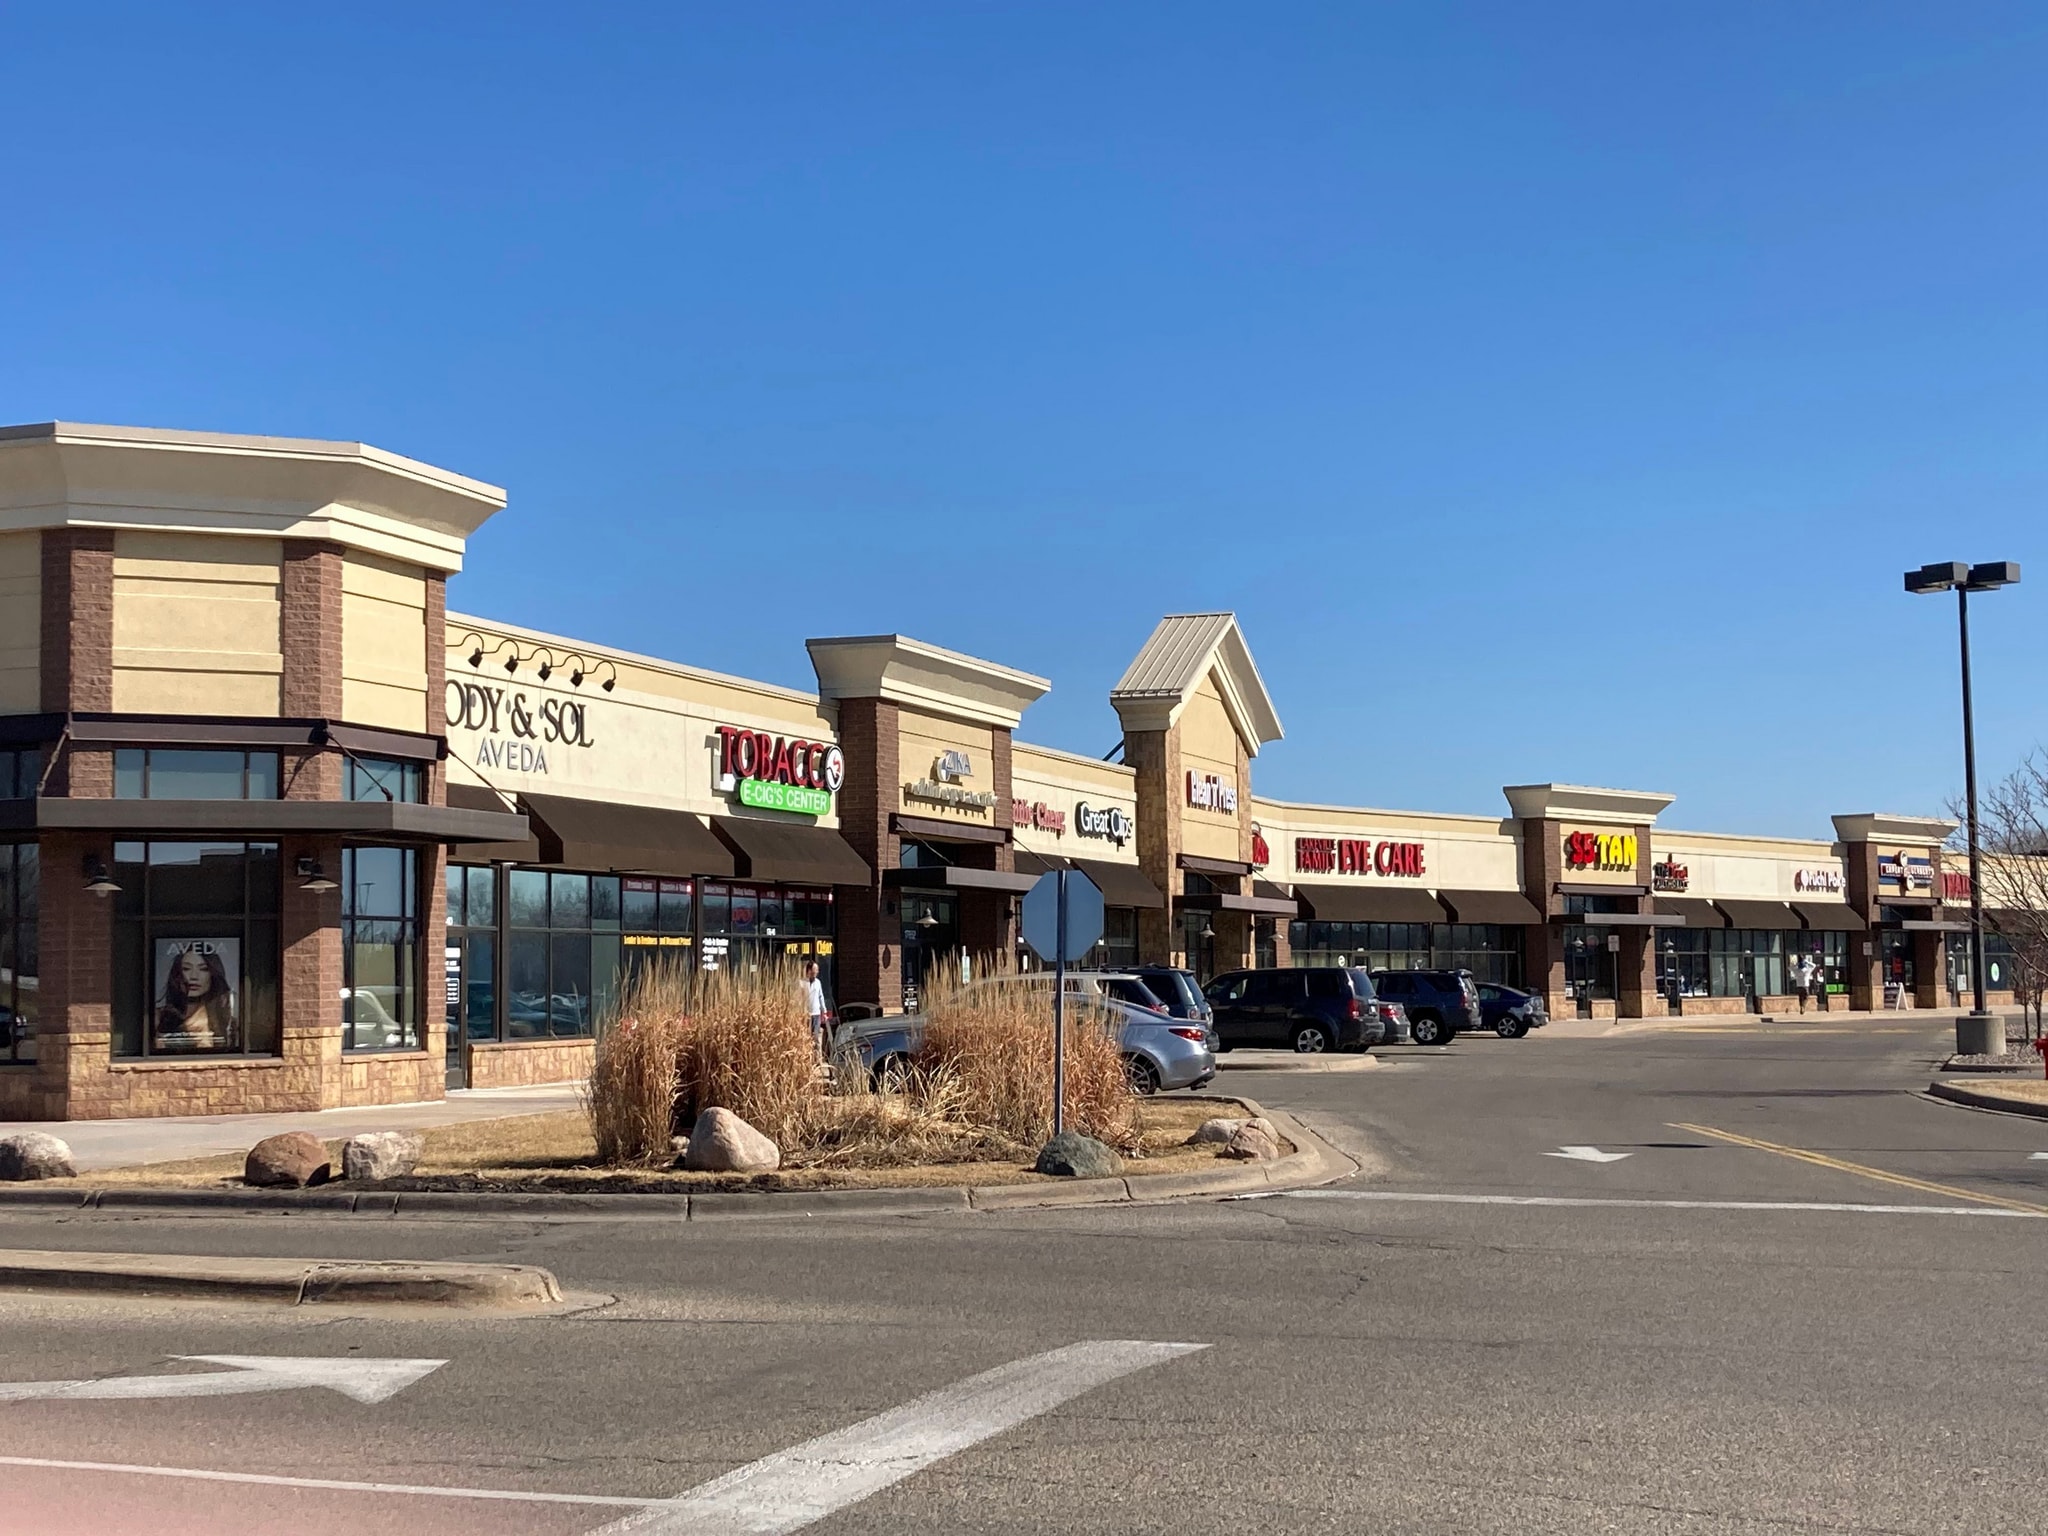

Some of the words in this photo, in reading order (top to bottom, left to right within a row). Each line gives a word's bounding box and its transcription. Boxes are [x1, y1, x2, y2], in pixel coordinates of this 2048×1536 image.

[445, 679, 505, 733] ODY
[511, 692, 538, 740] &
[544, 698, 594, 748] SOL
[476, 737, 548, 775] AVEDA
[743, 782, 784, 804] E-CIG'S
[786, 790, 828, 811] CENTER
[1080, 803, 1110, 833] Great
[1111, 808, 1133, 843] Clips
[1299, 850, 1336, 870] FAMILY
[1339, 839, 1372, 872] EYE
[1378, 841, 1426, 874] CARE
[1597, 835, 1637, 867] TAN
[166, 942, 229, 956] AVEDA
